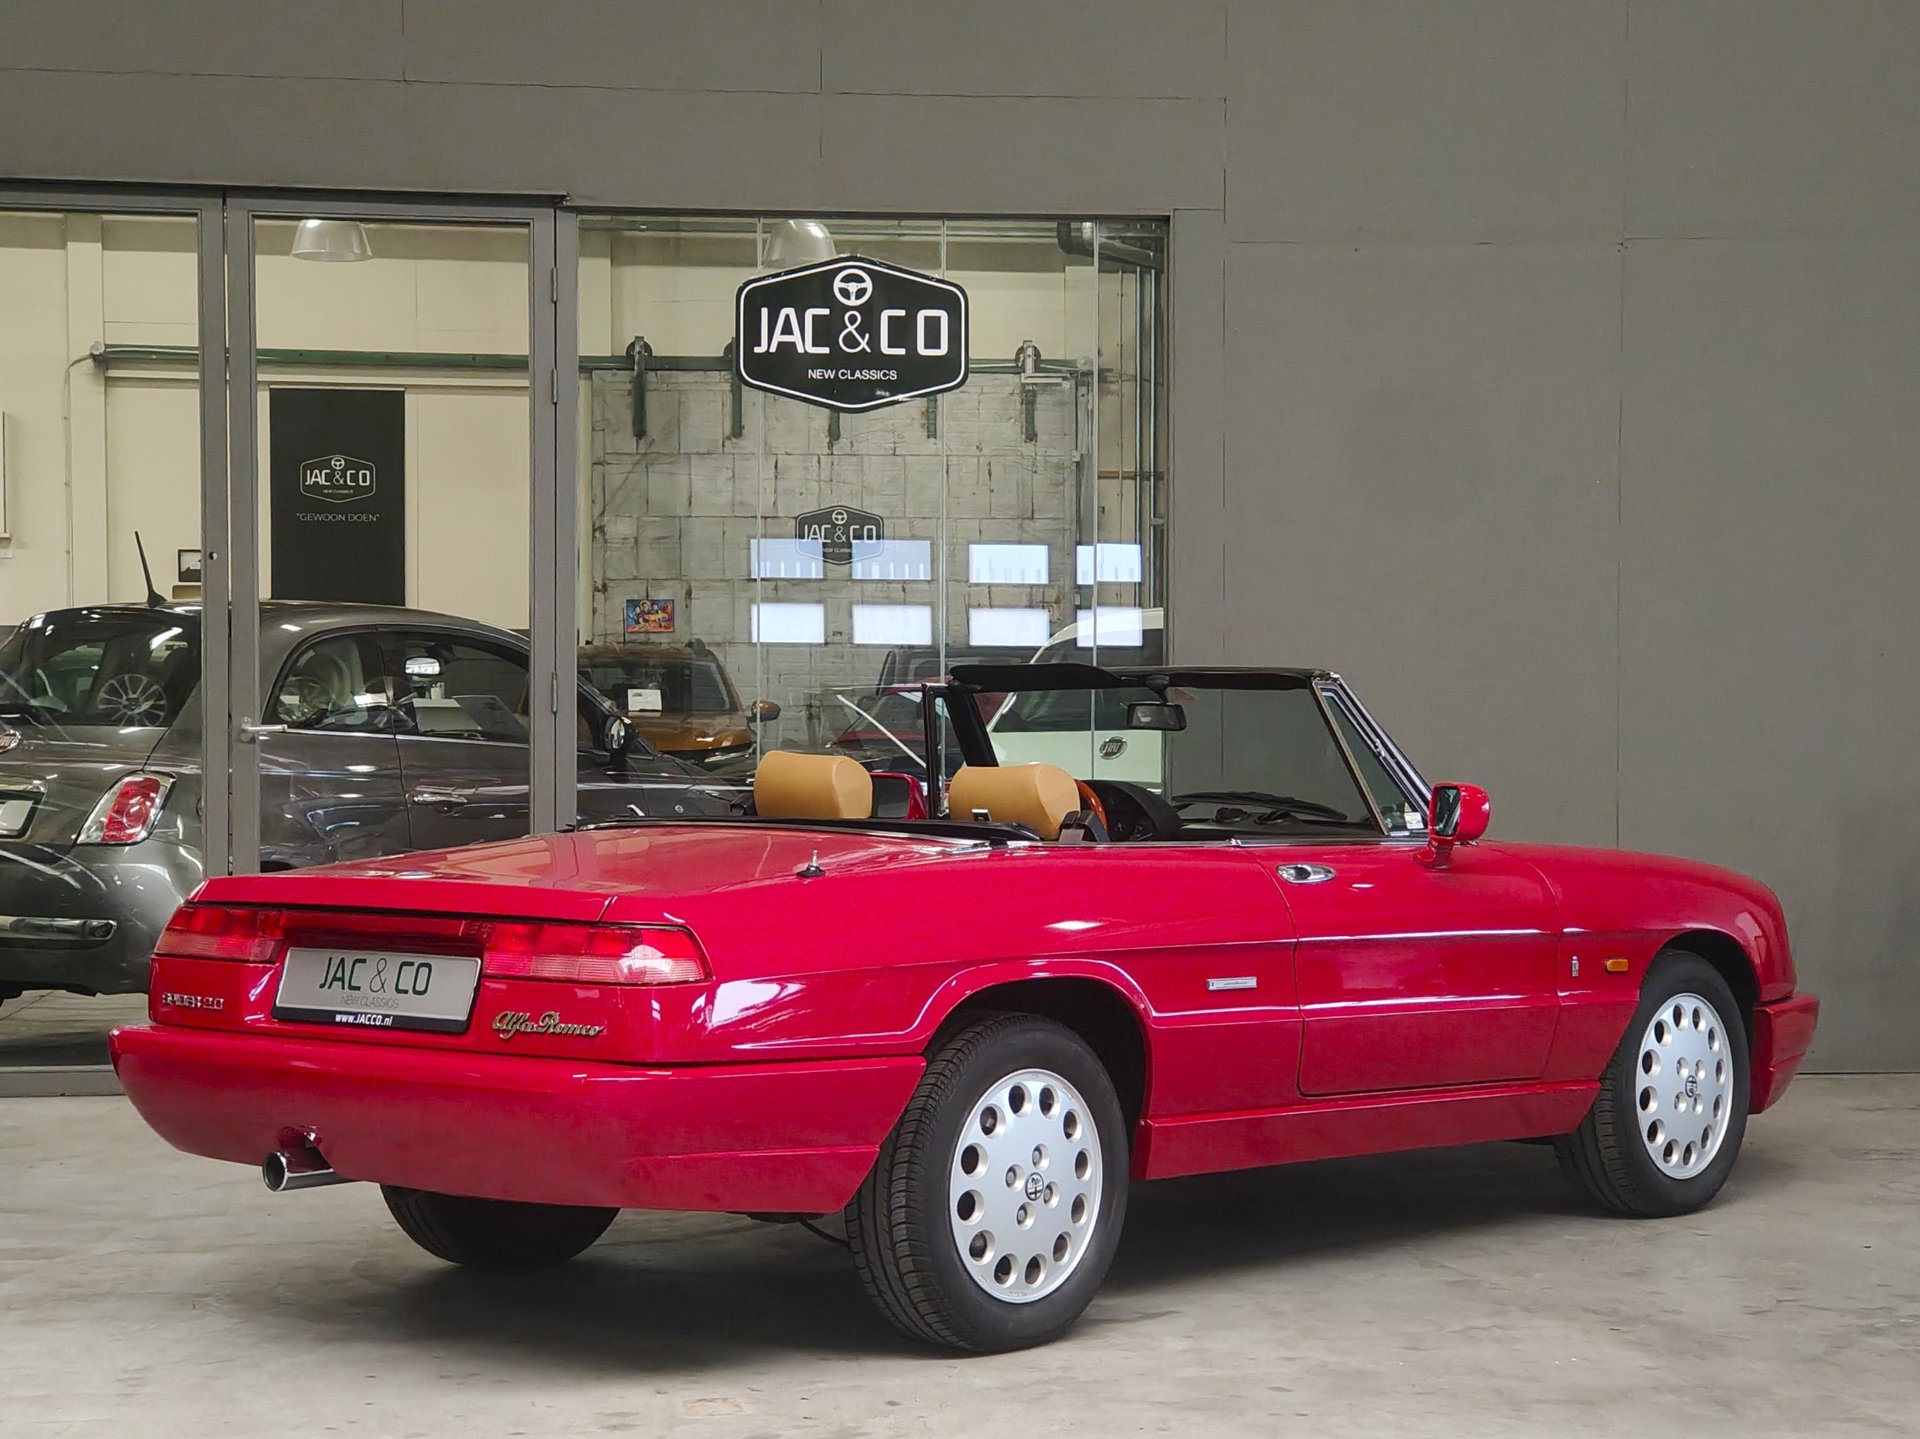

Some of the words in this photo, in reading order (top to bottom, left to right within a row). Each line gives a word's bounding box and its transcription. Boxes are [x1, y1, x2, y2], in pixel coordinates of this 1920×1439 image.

[753, 307, 831, 354] JAC
[838, 310, 872, 353] &
[808, 369, 836, 380] NEW
[838, 369, 897, 381] CLASSICS
[305, 469, 331, 486] JAC
[319, 956, 367, 992] JAC
[369, 957, 388, 994] &
[394, 960, 433, 996] CO
[334, 1013, 394, 1027] www.JACCO.nl
[538, 1010, 605, 1037] Romeo
